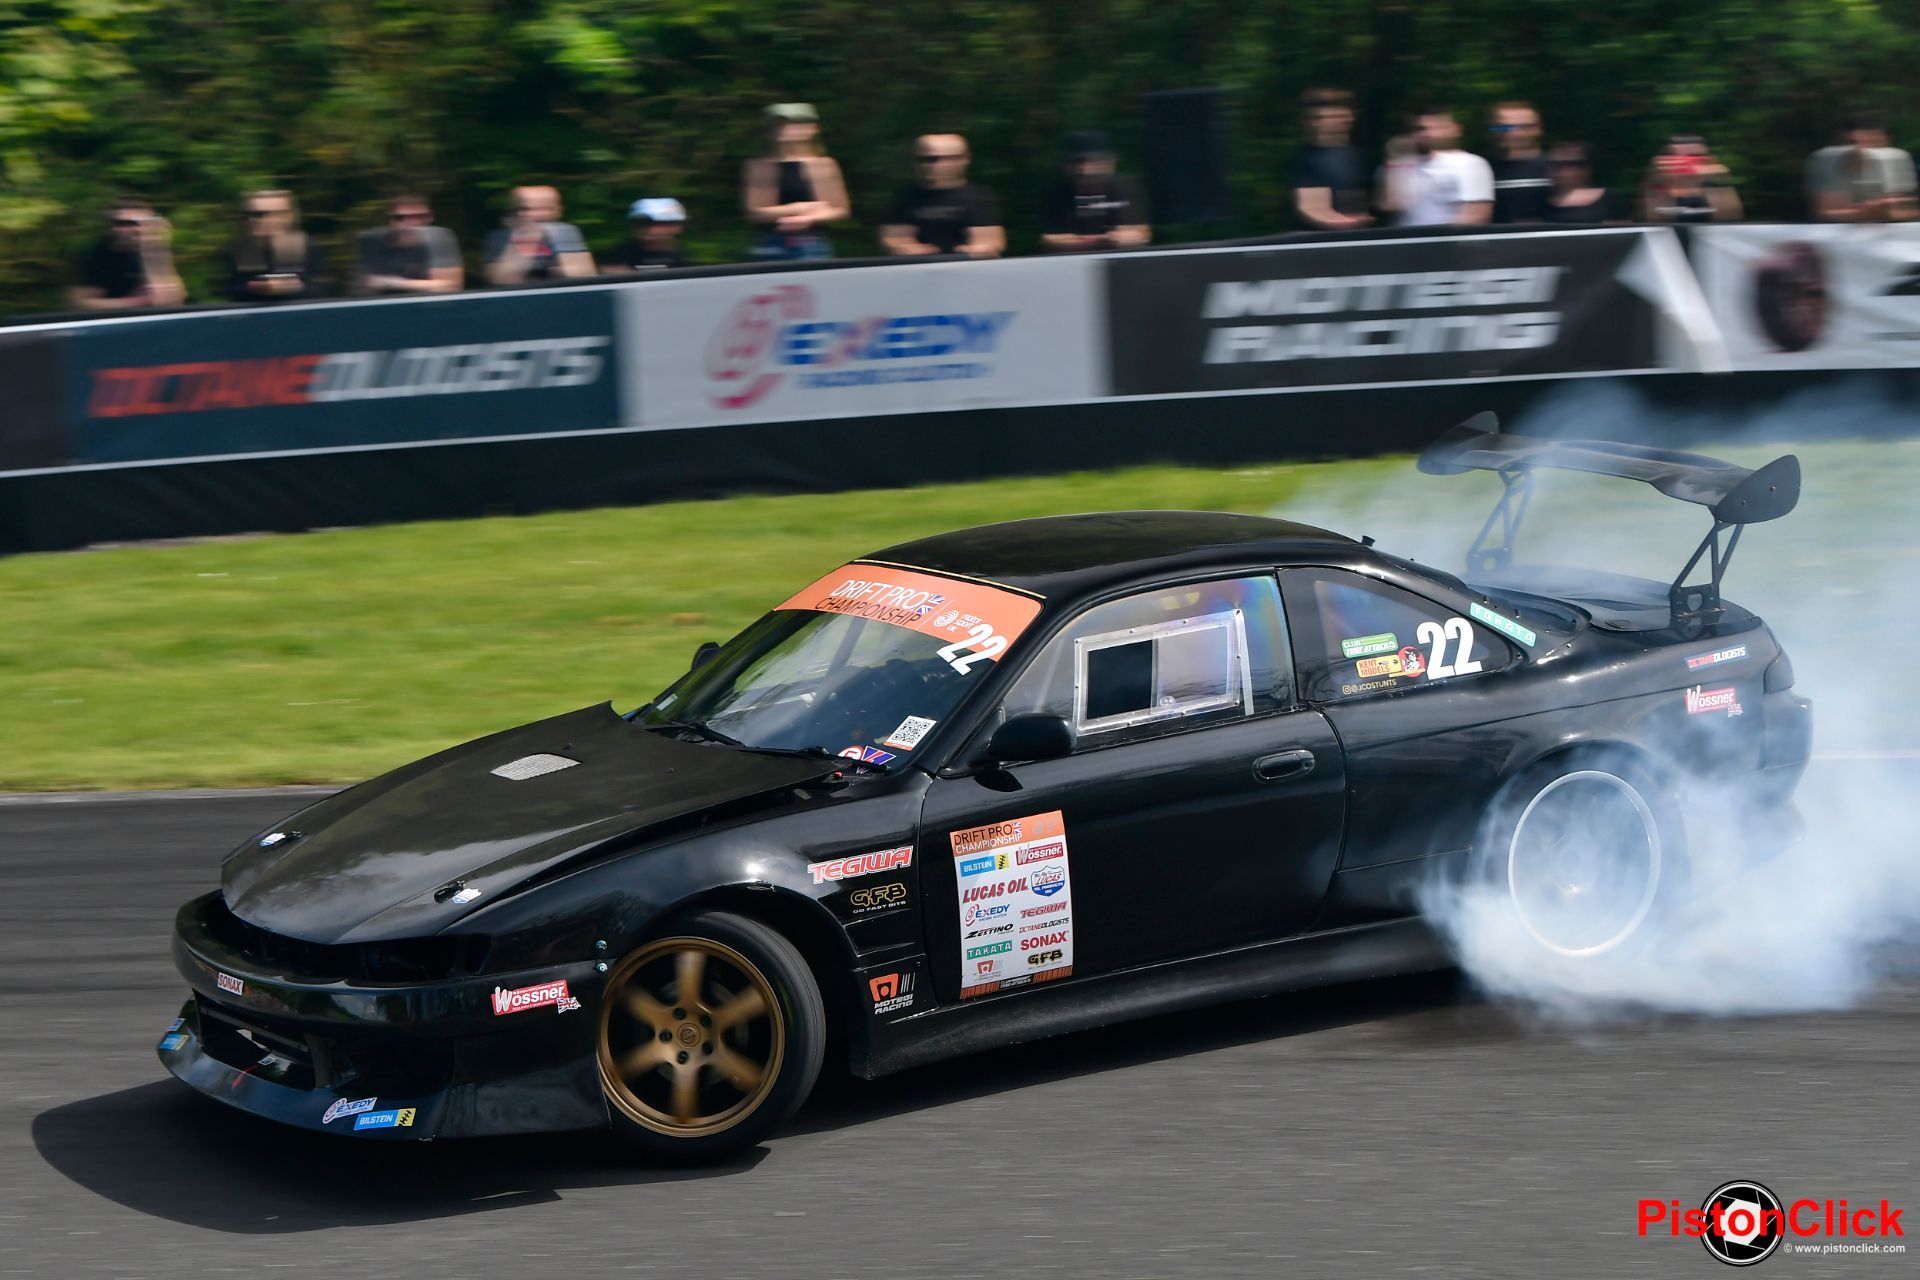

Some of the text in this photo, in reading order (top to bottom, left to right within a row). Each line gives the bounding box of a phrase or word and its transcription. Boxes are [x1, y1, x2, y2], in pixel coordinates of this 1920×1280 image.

[829, 580, 930, 610] DRIFT PRO
[815, 597, 922, 625] CHAMPIONSHIP
[1473, 604, 1534, 644] TAKATA
[936, 624, 1008, 675] 22
[1416, 617, 1482, 680] 22
[1359, 659, 1377, 669] KENT
[1361, 665, 1391, 676] MODELS
[954, 824, 1013, 845] DRIFT PRO
[955, 833, 1023, 854] CHAMPIONSHIP
[808, 845, 913, 884] TEGIWA
[963, 861, 992, 873] BILSTEIN
[1036, 873, 1061, 885] LUCAS
[850, 883, 907, 906] GFB
[963, 877, 1028, 903] LUCAS OIL
[888, 900, 906, 908] BITS
[975, 904, 1010, 918] EXEDY
[1020, 901, 1068, 919] TEGIWA
[964, 924, 1014, 940] ZESTINO
[1019, 918, 1069, 933] OCTANEOLOGISTS
[1021, 931, 1067, 950] SONAX
[968, 943, 1011, 958] TAKATA
[1028, 950, 1063, 965] GFB
[218, 974, 242, 993] SONAX
[874, 993, 914, 1009] MOTEGI
[874, 1000, 914, 1015] RACING
[337, 1098, 375, 1113] EXEDY
[360, 1115, 393, 1125] BILSTEIN
